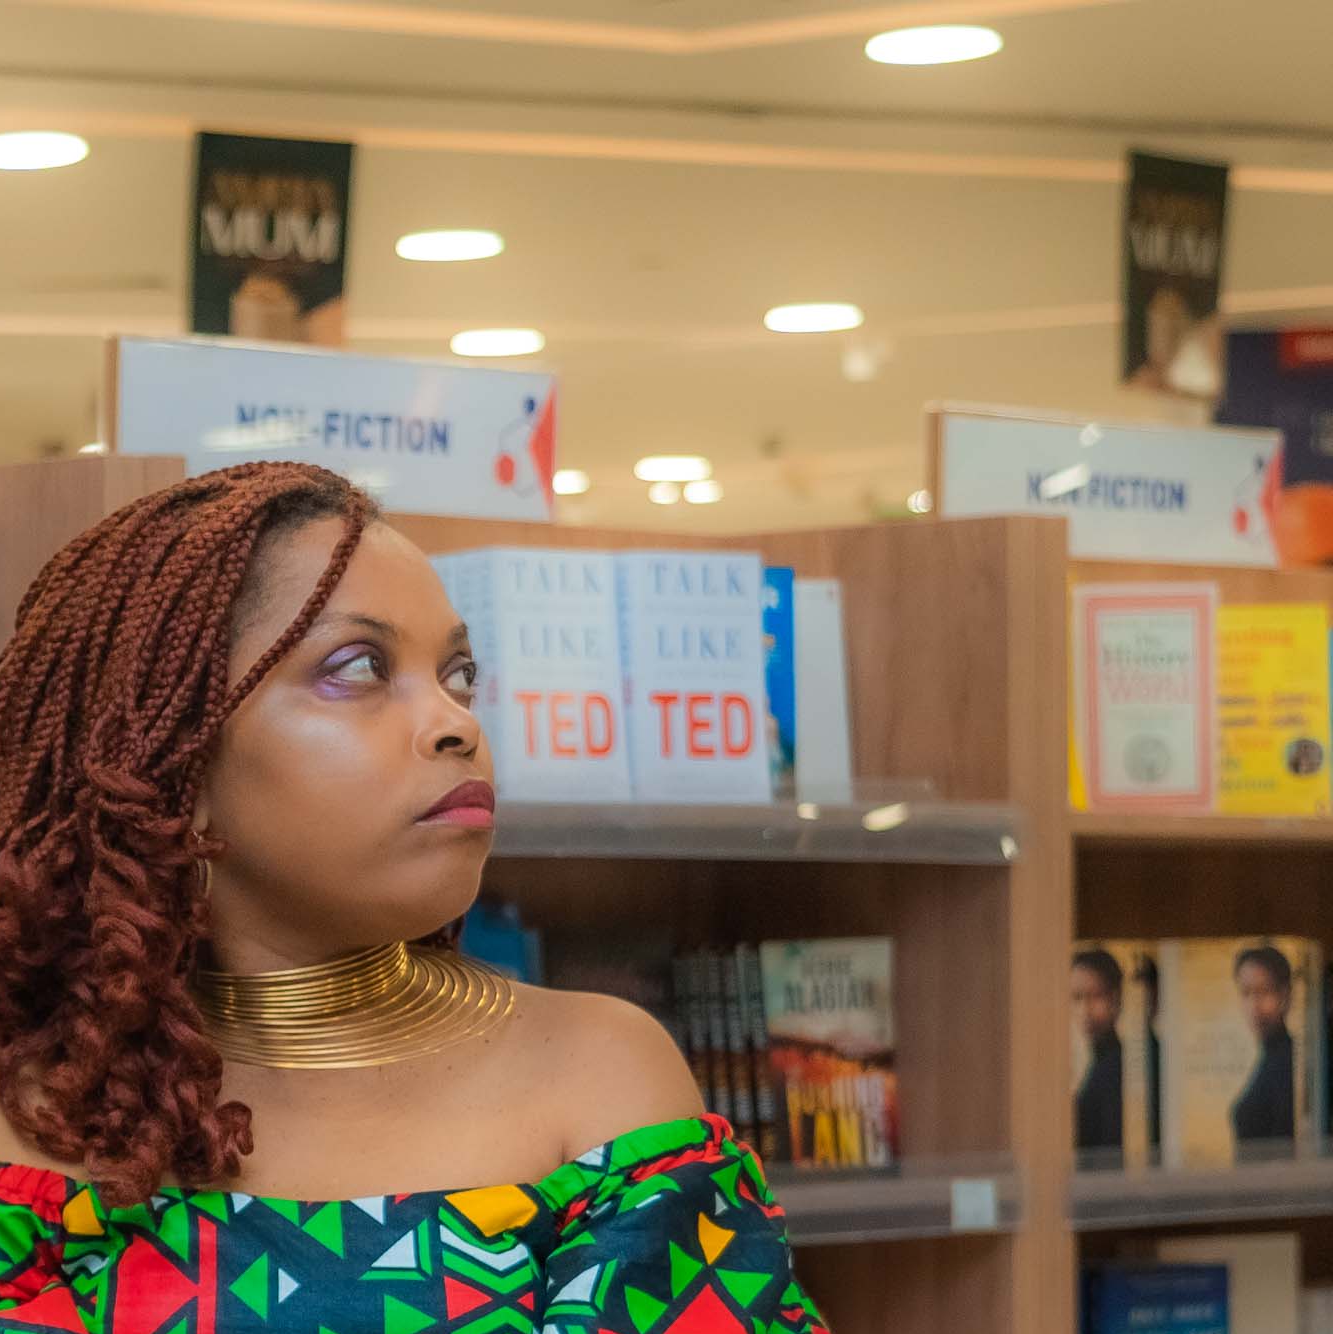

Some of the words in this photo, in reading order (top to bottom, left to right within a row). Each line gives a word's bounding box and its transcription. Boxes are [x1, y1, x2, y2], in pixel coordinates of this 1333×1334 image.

[508, 559, 603, 596] TALK
[648, 561, 745, 597] TALK
[518, 624, 600, 658] LIKE
[656, 625, 743, 660] LIKE
[512, 690, 617, 758] TED
[648, 691, 756, 759] TED
